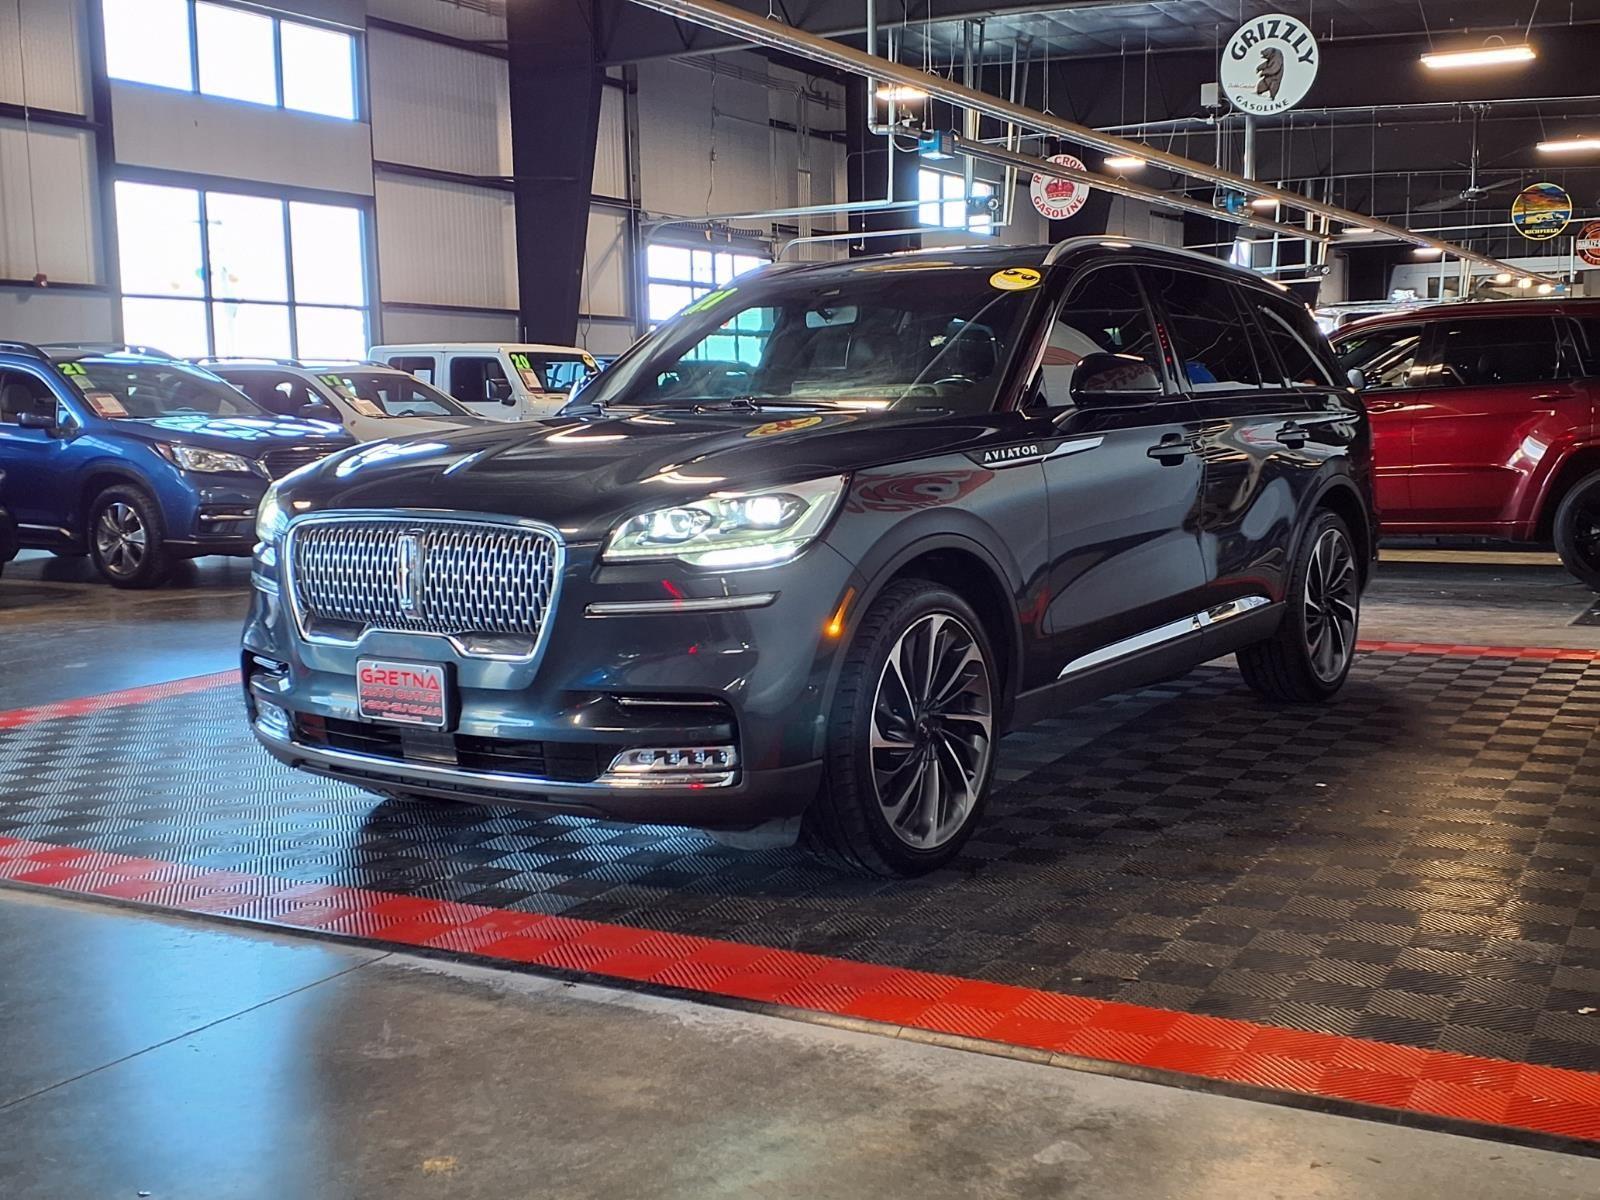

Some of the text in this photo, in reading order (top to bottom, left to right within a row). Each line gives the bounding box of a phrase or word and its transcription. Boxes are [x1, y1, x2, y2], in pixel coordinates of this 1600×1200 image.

[1231, 20, 1314, 65] GRIZZLY
[1236, 95, 1289, 112] GASOLINE
[1033, 195, 1085, 218] GASOLINE
[57, 362, 87, 375] 21
[510, 354, 531, 369] 20
[984, 445, 1038, 461] AVIATOR
[361, 669, 439, 690] GRETNA
